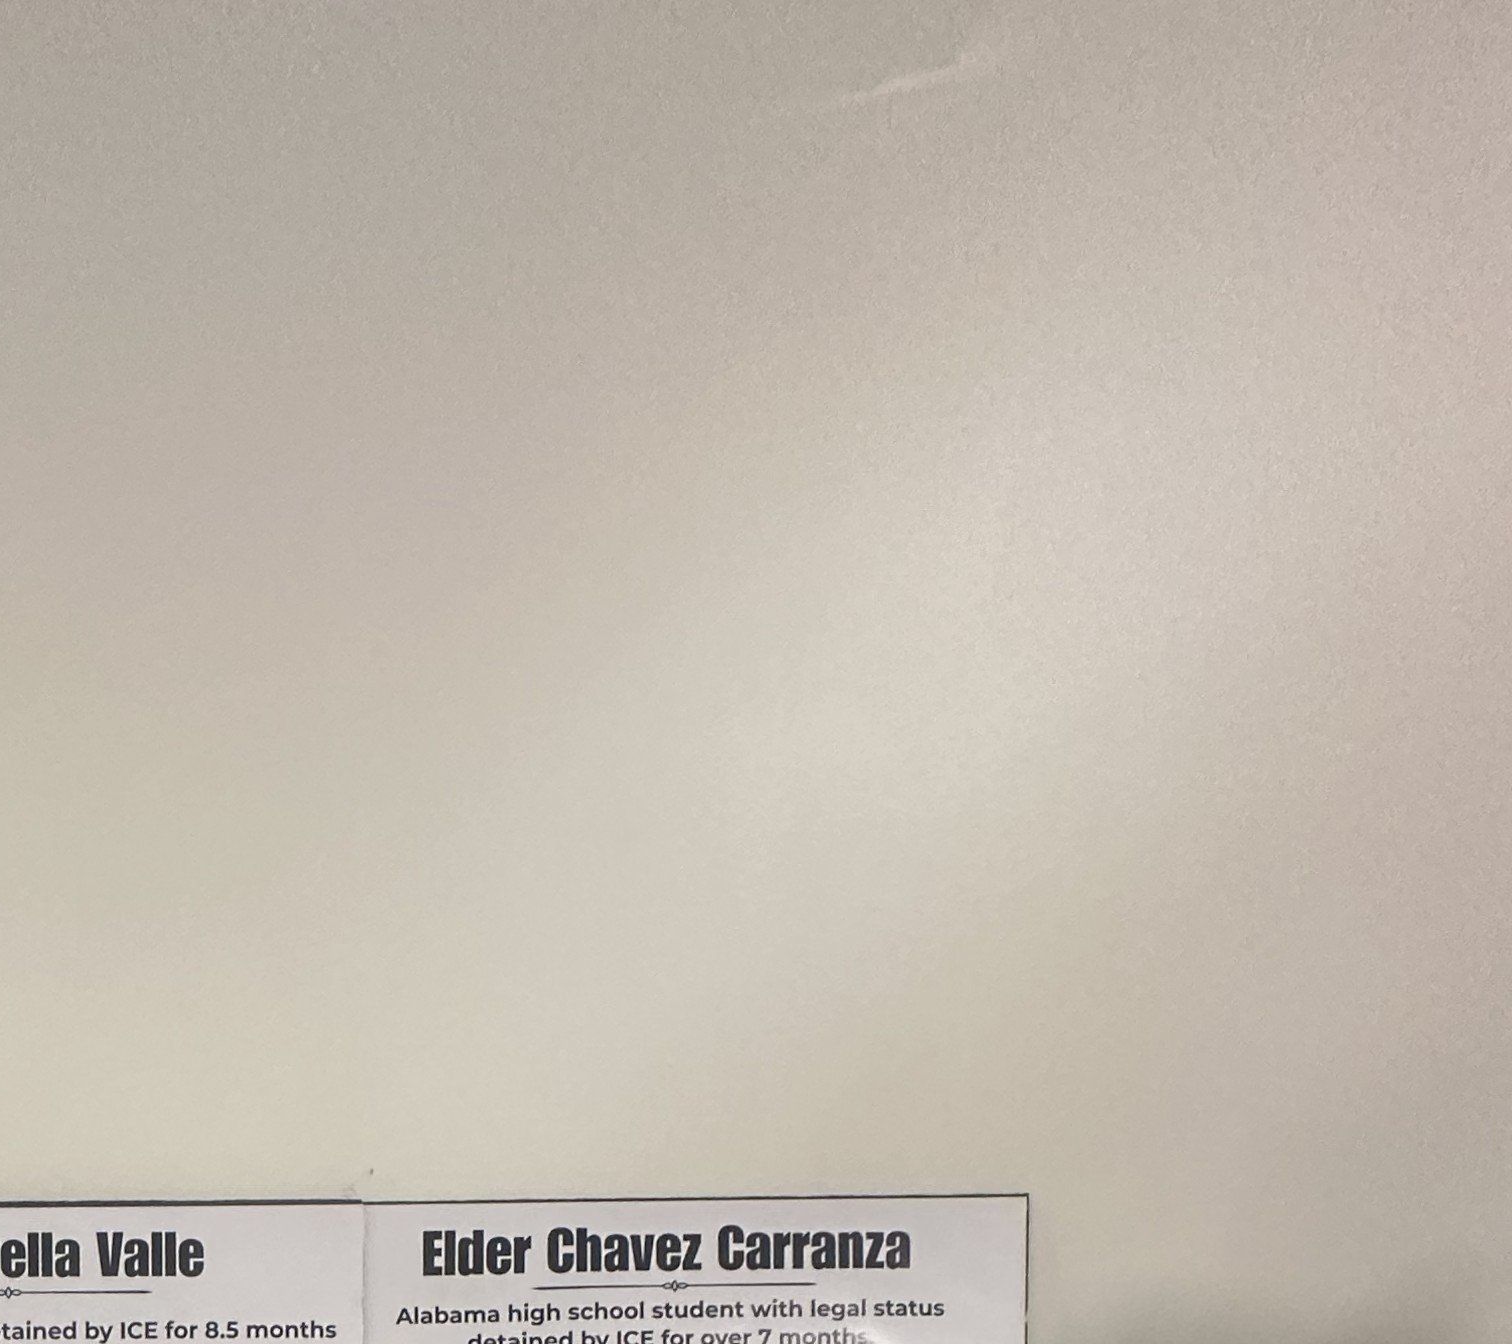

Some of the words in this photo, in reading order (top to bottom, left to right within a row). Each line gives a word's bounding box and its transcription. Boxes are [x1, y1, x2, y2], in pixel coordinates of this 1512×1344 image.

[95, 1230, 204, 1278] Valle
[421, 1228, 532, 1277] Elder
[546, 1226, 702, 1274] Chavez
[716, 1223, 911, 1271] Carranza
[395, 1304, 500, 1325] Alabama
[507, 1301, 561, 1326] high
[567, 1299, 645, 1321] school
[650, 1299, 744, 1319] student
[749, 1297, 803, 1318] with
[809, 1297, 866, 1321] legal
[872, 1299, 945, 1317] status
[84, 1320, 113, 1344] by
[119, 1320, 158, 1340] ICE
[163, 1319, 198, 1339] for
[204, 1320, 239, 1339] 8.5
[245, 1319, 337, 1339] months
